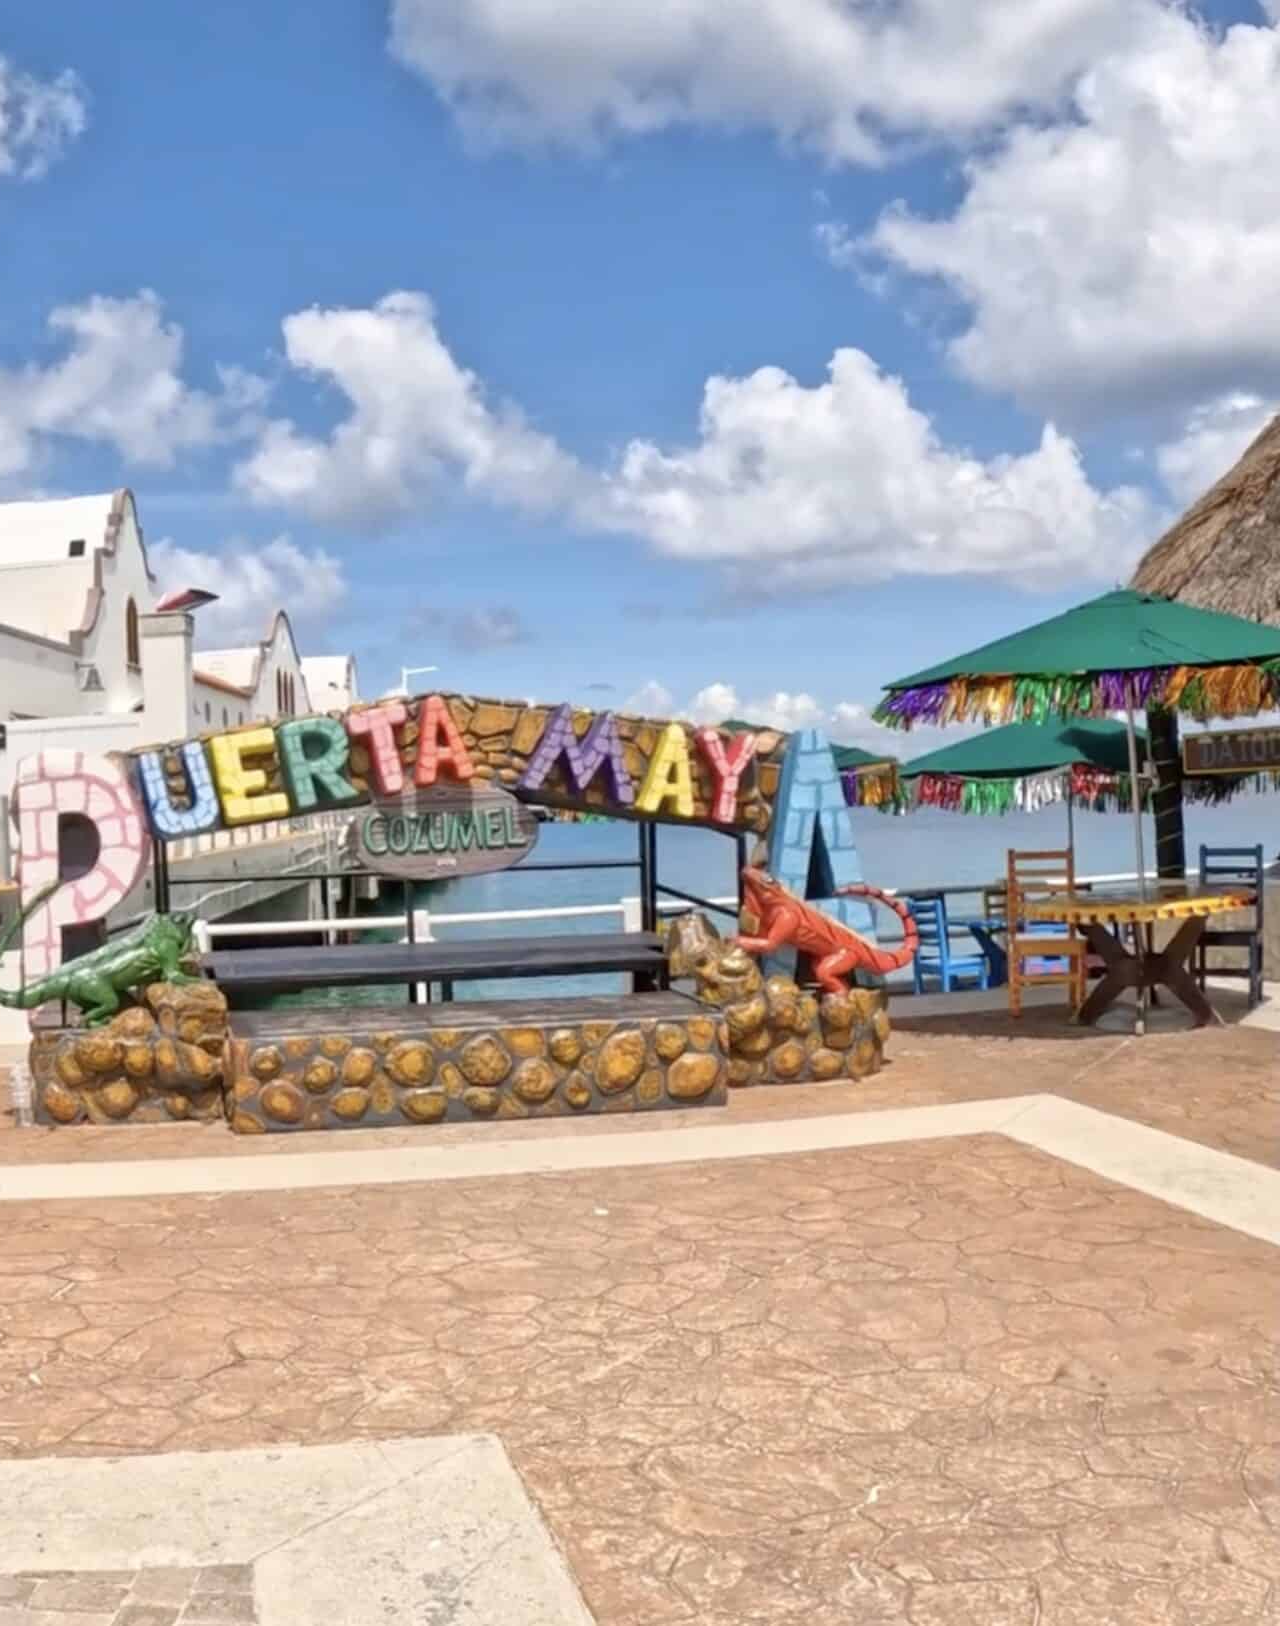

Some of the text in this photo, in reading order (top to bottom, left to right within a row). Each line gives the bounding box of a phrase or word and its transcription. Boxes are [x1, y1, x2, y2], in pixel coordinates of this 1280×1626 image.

[12, 695, 883, 1004] PUERTA MAYA
[363, 806, 528, 855] COZUMEL
